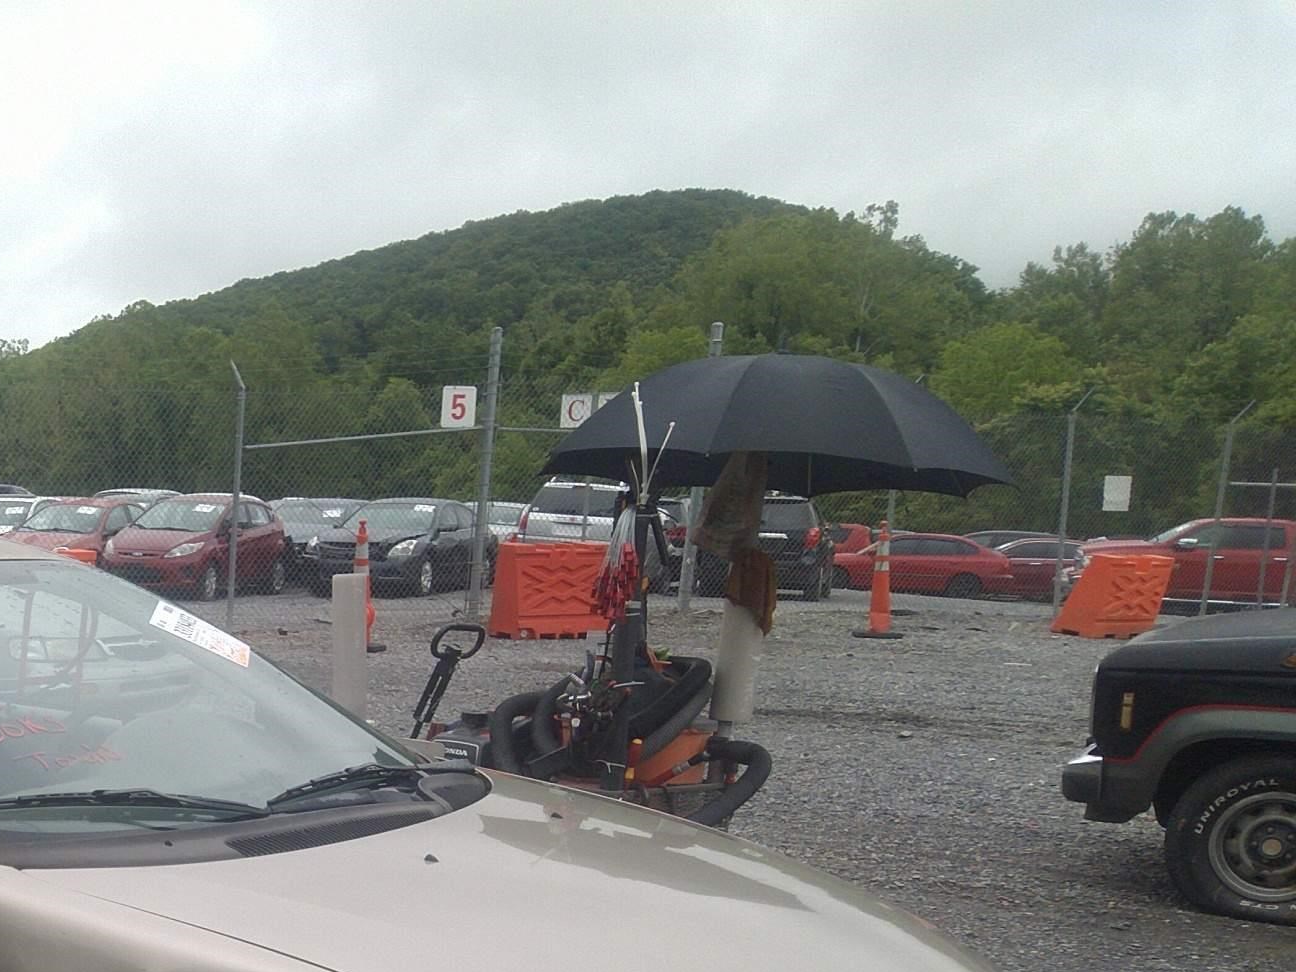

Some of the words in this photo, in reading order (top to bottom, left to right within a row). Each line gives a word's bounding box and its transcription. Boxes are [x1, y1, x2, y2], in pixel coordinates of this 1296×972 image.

[451, 394, 466, 420] 5
[568, 399, 584, 421] C
[445, 748, 468, 756] ONDA
[1194, 778, 1280, 834] UNIROYAL
